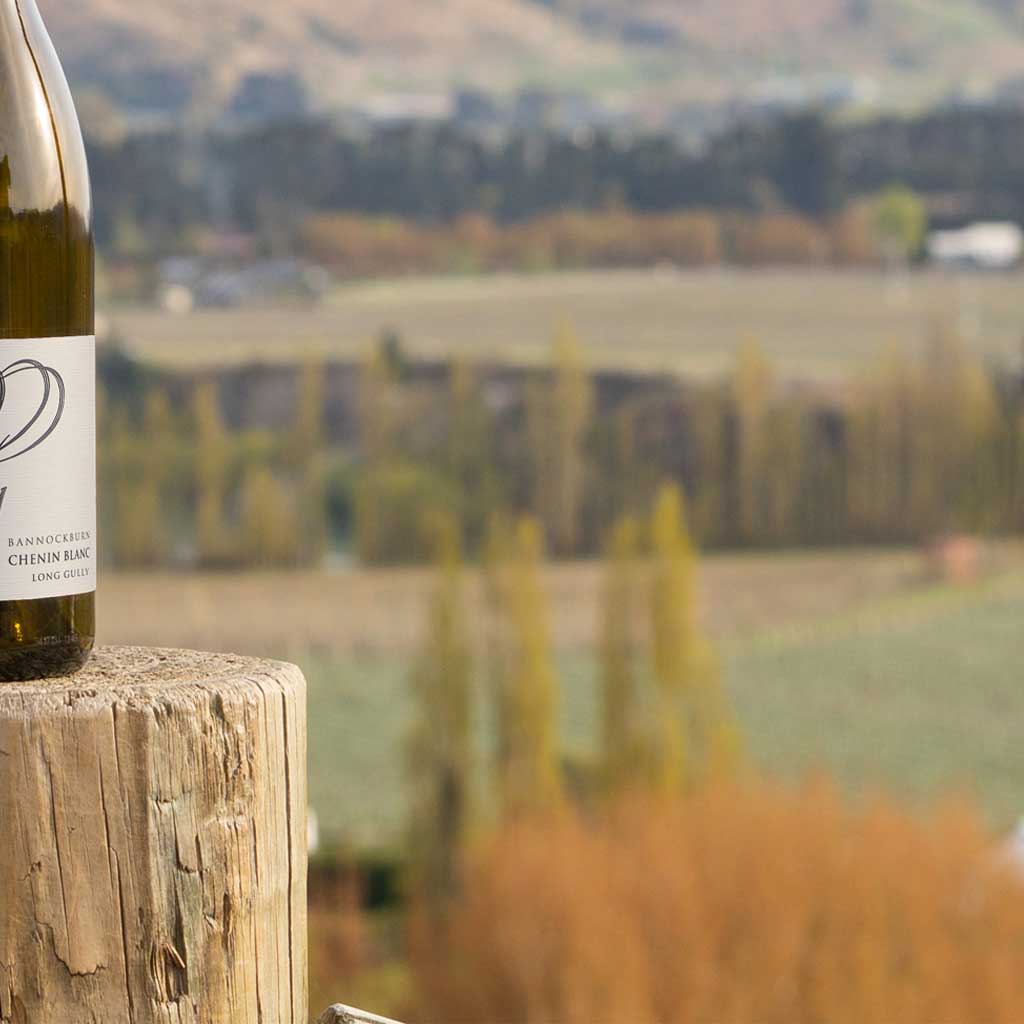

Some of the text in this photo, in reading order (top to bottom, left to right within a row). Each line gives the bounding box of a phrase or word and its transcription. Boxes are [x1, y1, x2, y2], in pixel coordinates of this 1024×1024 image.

[8, 530, 91, 548] BANNOCKBURN
[8, 547, 91, 567] CHENIN BLANC
[32, 567, 90, 582] LONG GULLY
